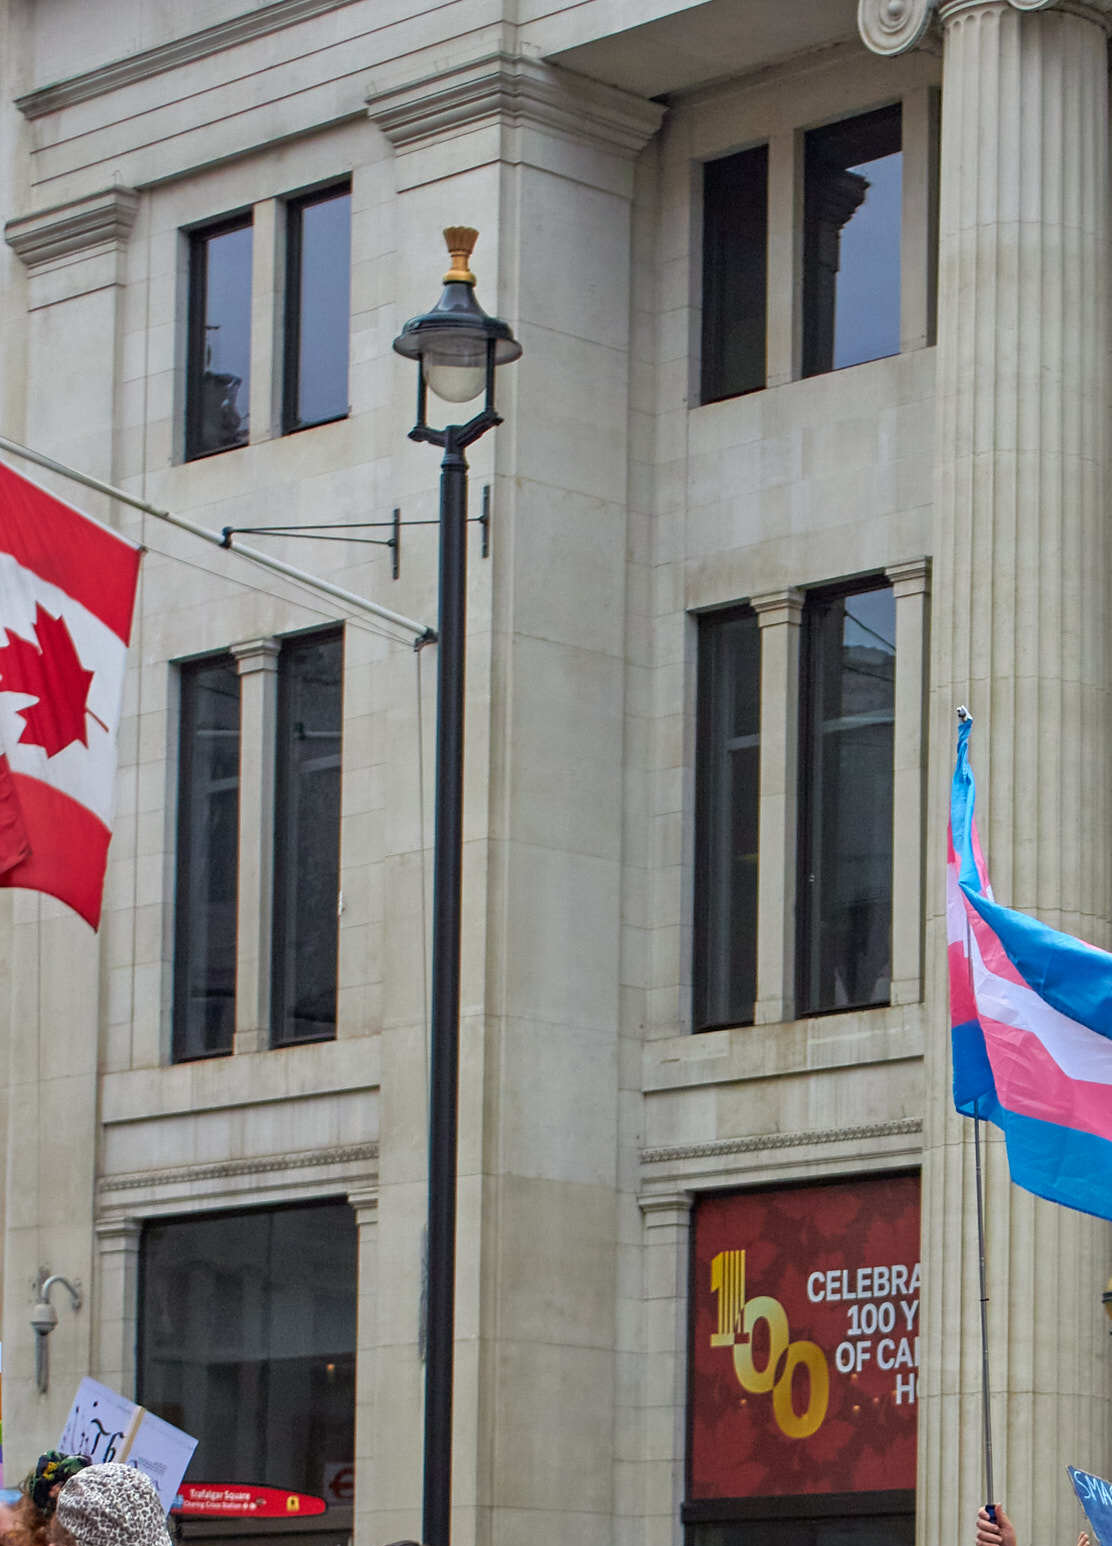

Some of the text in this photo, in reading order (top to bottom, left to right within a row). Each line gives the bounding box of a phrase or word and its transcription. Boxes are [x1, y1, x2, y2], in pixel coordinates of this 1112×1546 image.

[847, 1301, 896, 1336] 100
[835, 1340, 872, 1373] OF
[896, 1373, 919, 1405] H
[224, 1490, 251, 1501] Square
